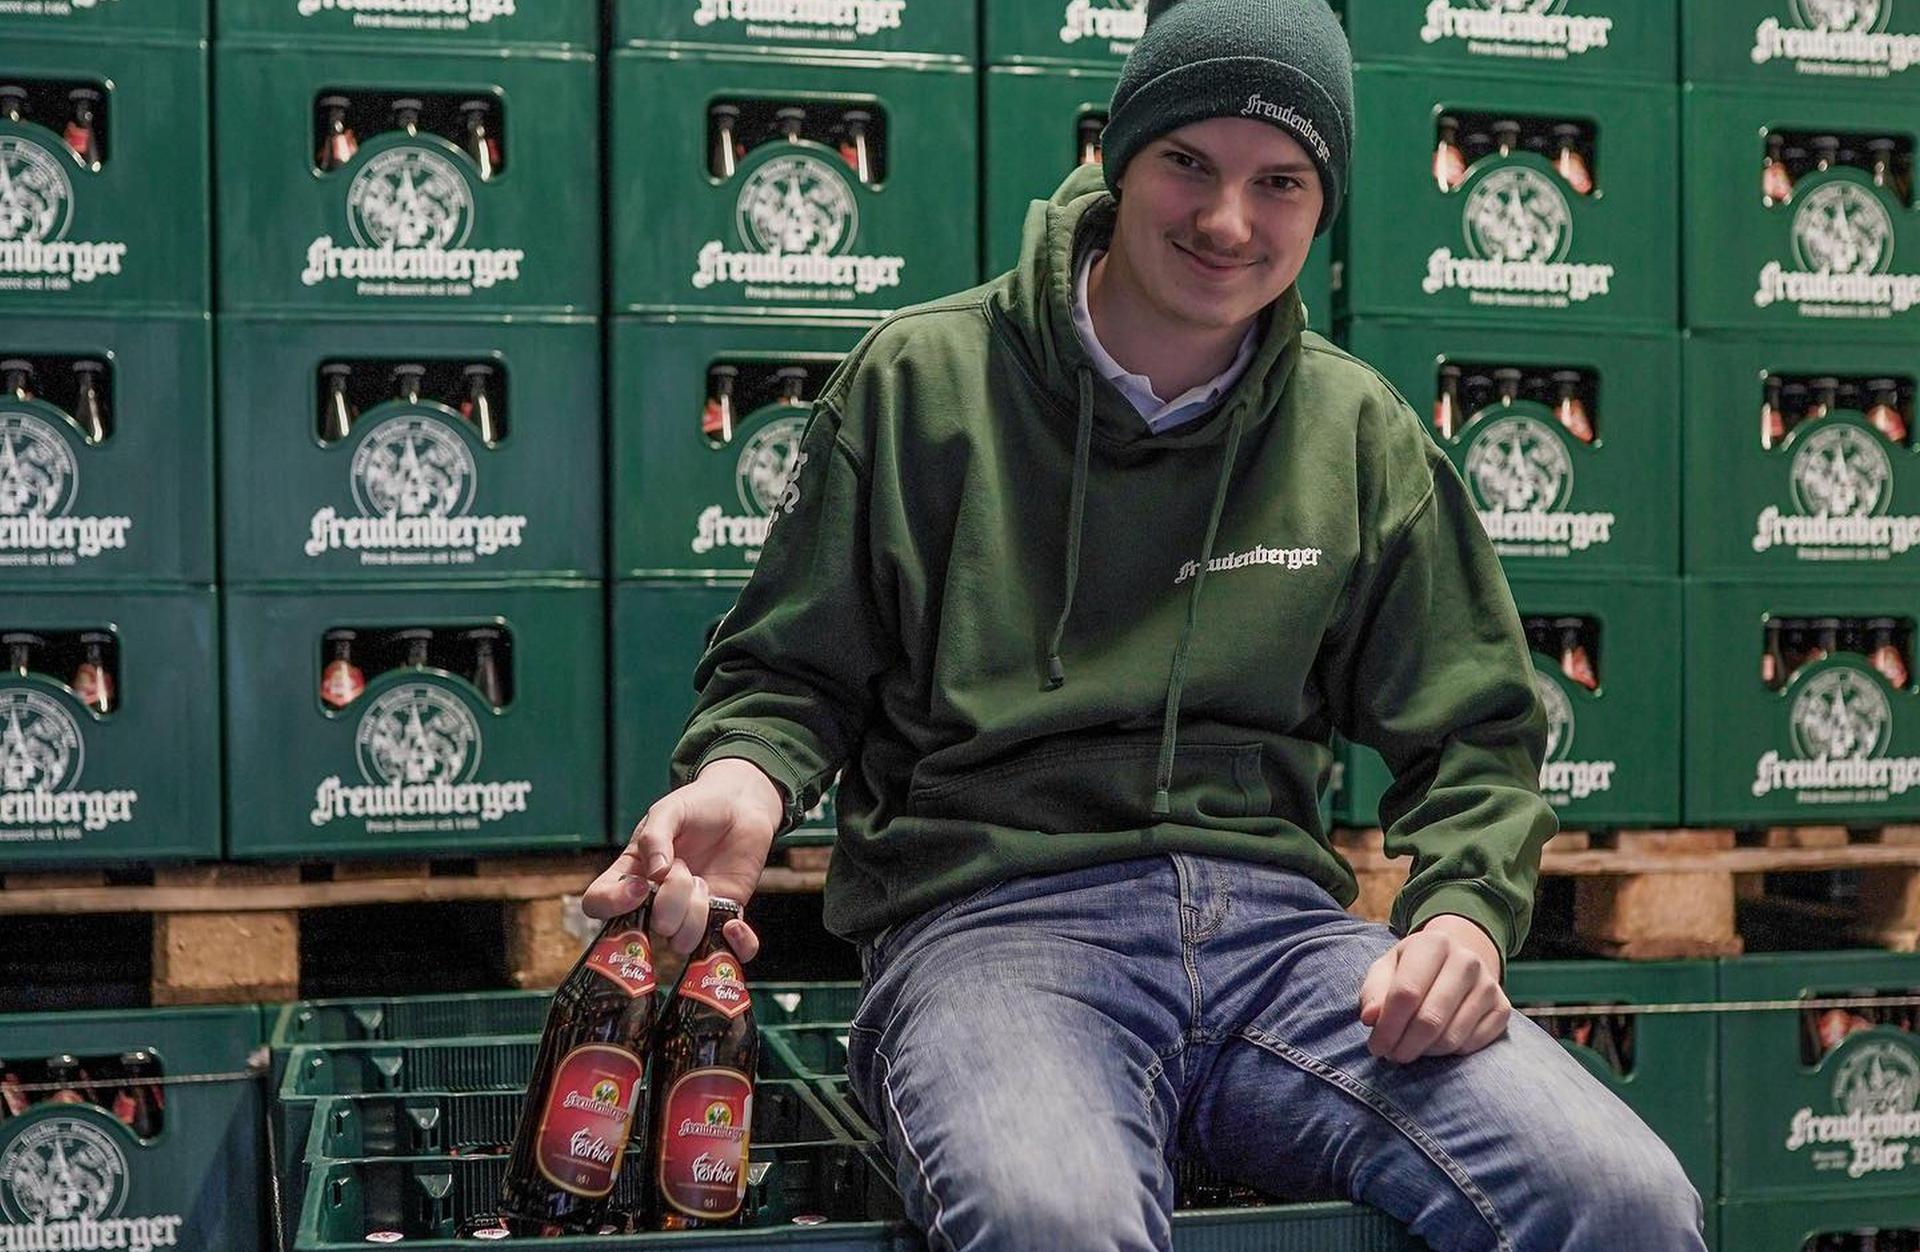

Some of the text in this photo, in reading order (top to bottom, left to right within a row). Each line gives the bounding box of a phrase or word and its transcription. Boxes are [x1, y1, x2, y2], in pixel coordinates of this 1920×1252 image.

[1420, 0, 1613, 53] Freudenberger
[1751, 16, 1920, 71] Freudenberge
[301, 235, 524, 287] Freudenberger
[692, 239, 905, 293] Freudenberger
[1423, 247, 1614, 300] Freudenberger
[1754, 261, 1920, 311] Freudenberge
[305, 506, 527, 556] Freudenberger
[1752, 505, 1920, 553] Freudenberge
[1752, 750, 1920, 797] Freudenberge
[310, 775, 532, 826] Freudenberger
[570, 1126, 614, 1164] Festbier
[691, 1152, 736, 1184] Festbier
[1848, 1140, 1909, 1178] Bier
